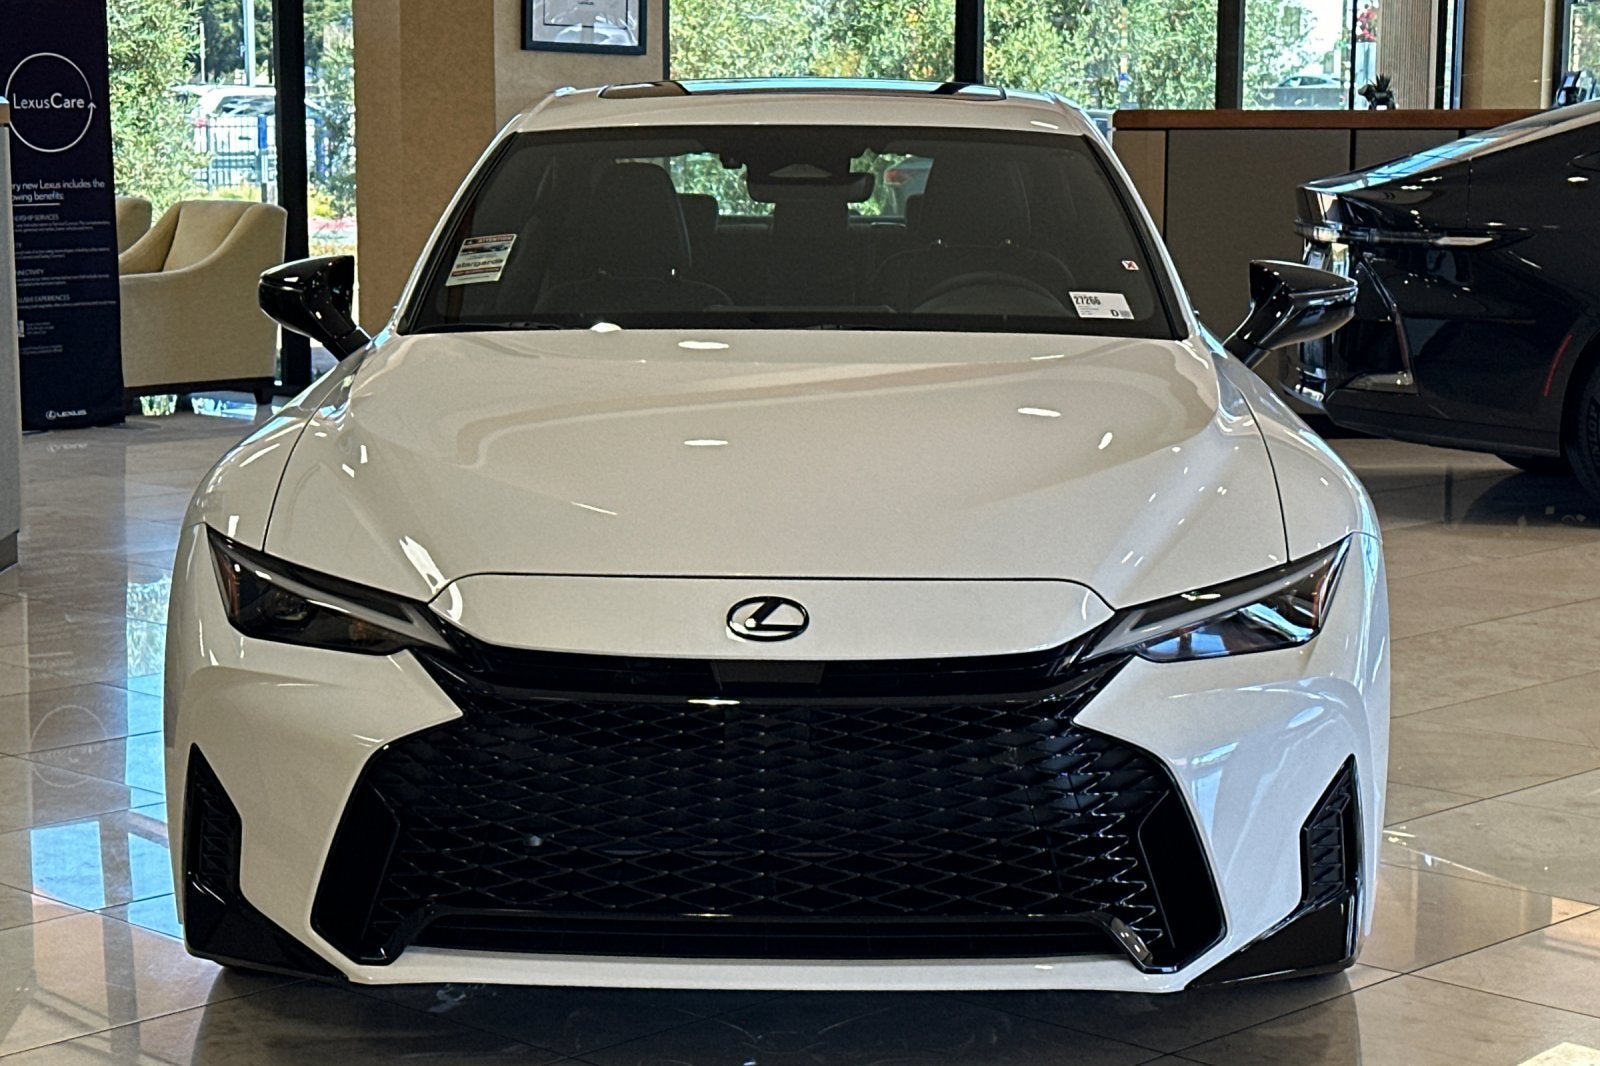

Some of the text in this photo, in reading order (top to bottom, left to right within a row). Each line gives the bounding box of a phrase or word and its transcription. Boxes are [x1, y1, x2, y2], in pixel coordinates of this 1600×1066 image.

[13, 93, 85, 109] LexusCare
[39, 179, 61, 190] Lexus
[62, 179, 92, 189] includes
[92, 179, 105, 188] the
